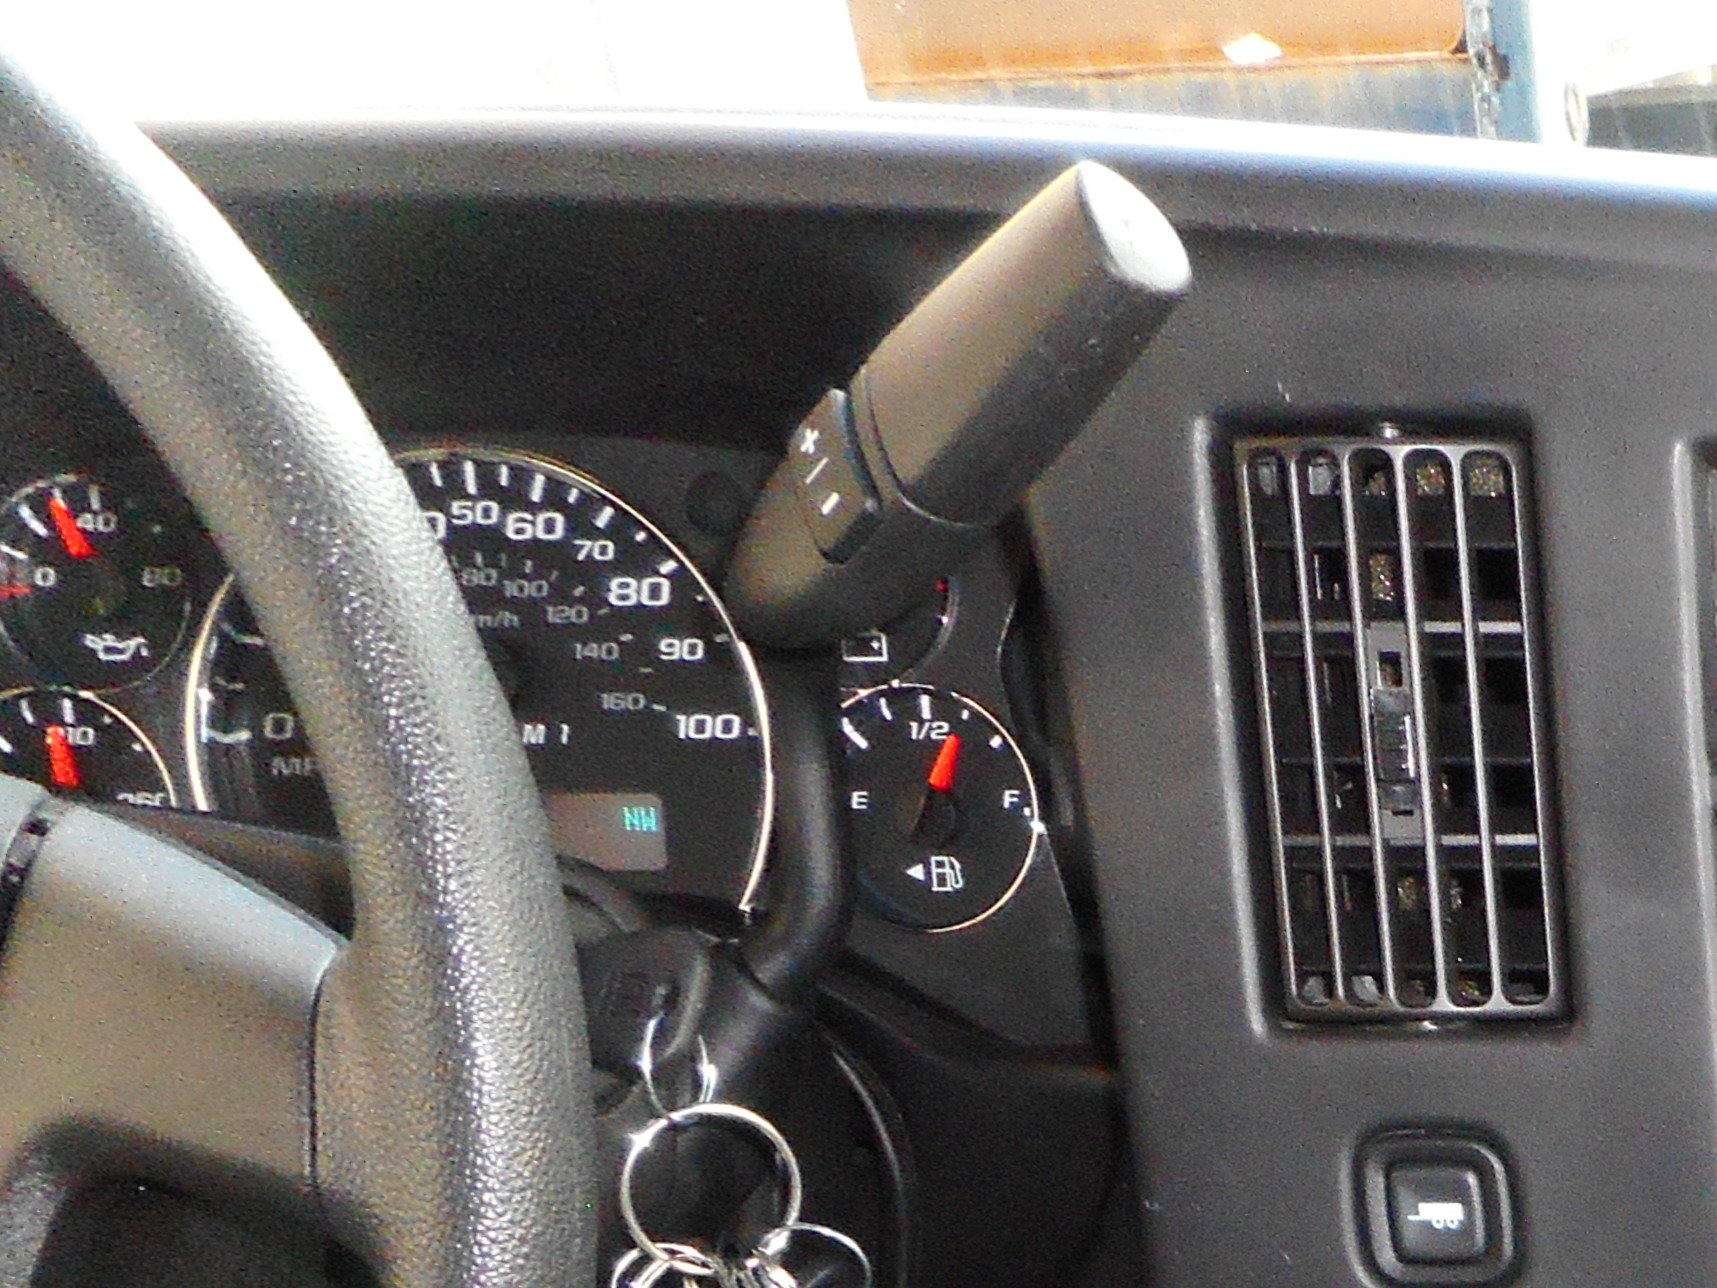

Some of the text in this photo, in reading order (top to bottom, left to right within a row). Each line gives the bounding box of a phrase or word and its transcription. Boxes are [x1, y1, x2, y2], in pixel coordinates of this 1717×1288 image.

[451, 501, 500, 525] 50
[505, 511, 565, 541] 60
[573, 540, 615, 562] 70
[461, 569, 498, 587] 80
[503, 579, 549, 598] 100
[608, 576, 671, 606] 80
[546, 605, 589, 624] 120
[574, 642, 619, 661] 140
[659, 637, 705, 662] 90
[601, 692, 645, 711] 160
[264, 713, 294, 740] 0
[675, 713, 741, 740] 100
[909, 721, 951, 741] 1/2
[851, 791, 868, 810] E
[1002, 789, 1020, 809] F
[622, 806, 657, 831] NW
